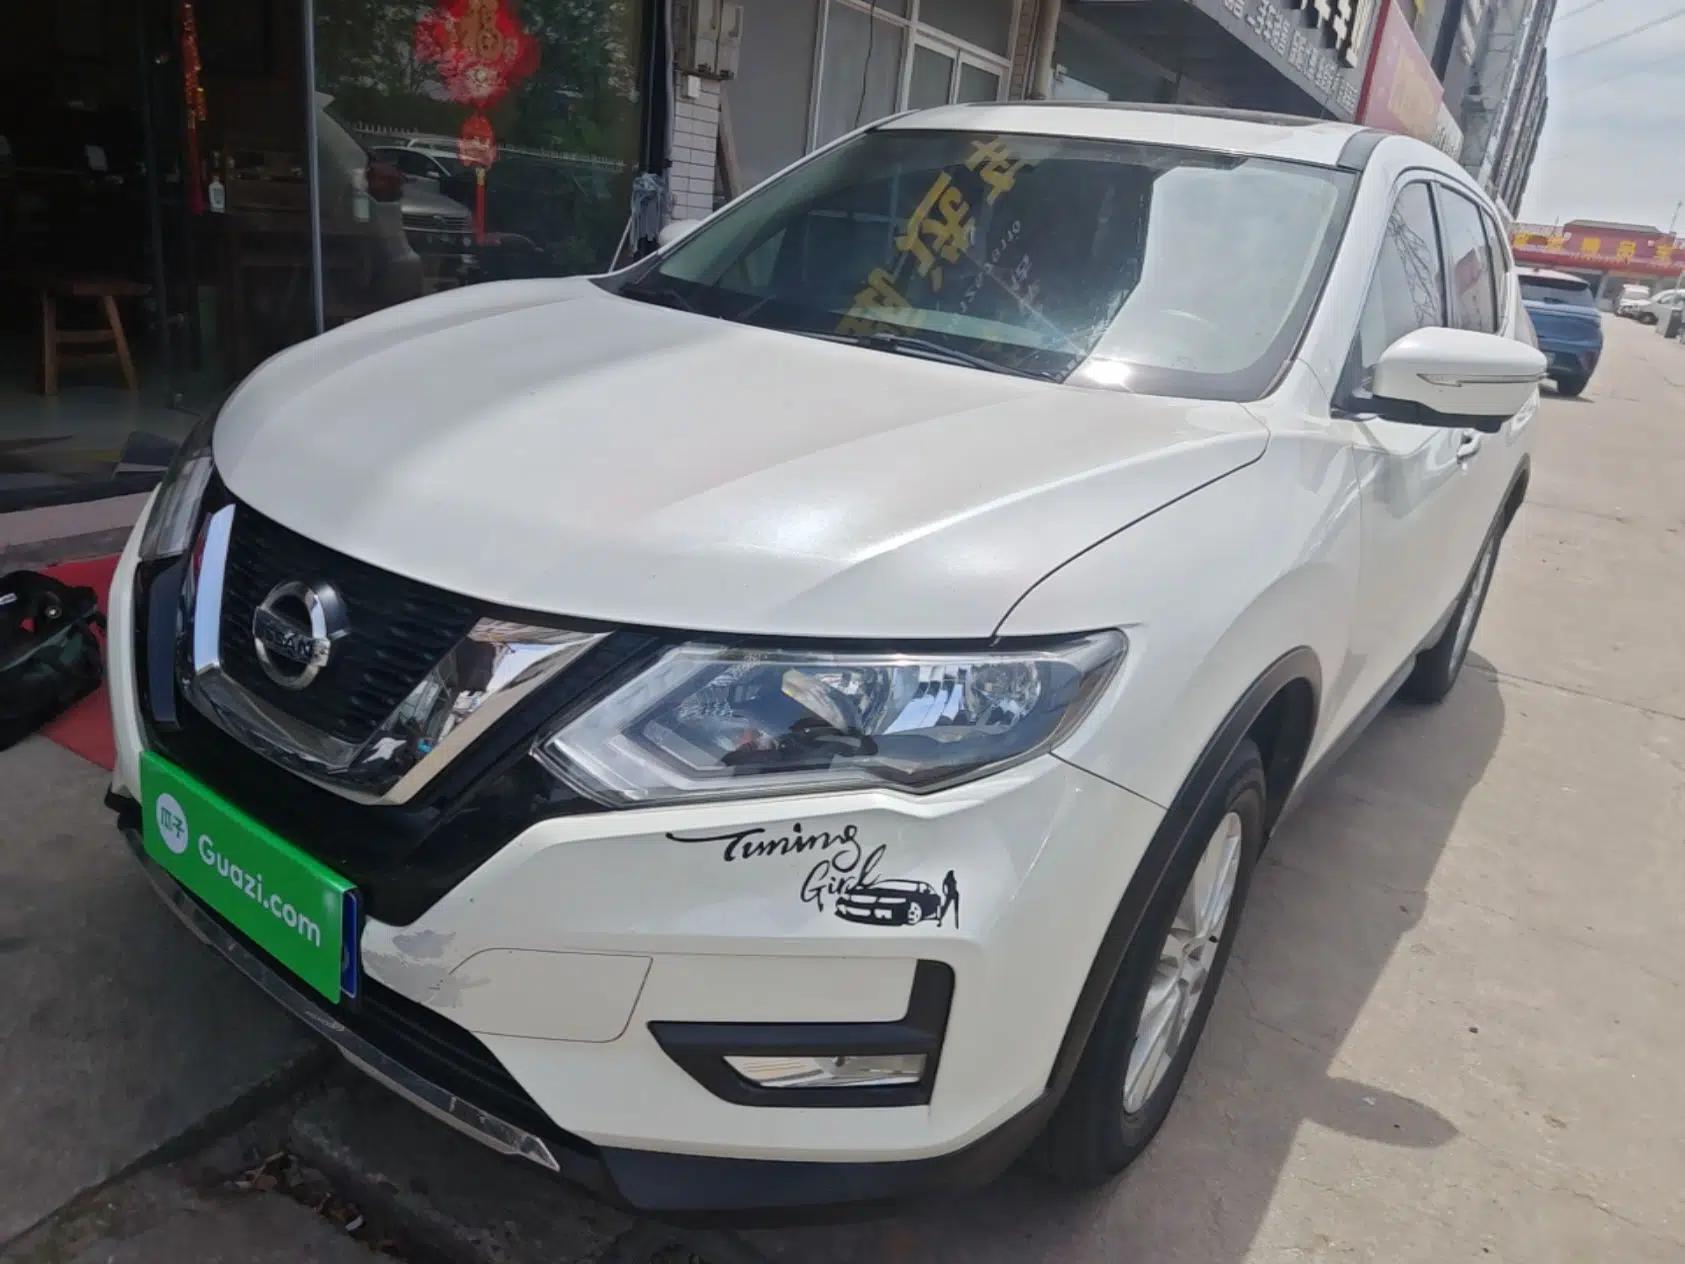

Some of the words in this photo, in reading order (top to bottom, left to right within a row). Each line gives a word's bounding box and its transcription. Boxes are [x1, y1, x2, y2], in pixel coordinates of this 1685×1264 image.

[161, 806, 185, 838] 瓜子
[198, 834, 320, 947] Guazi.com
[801, 844, 886, 912] Girl
